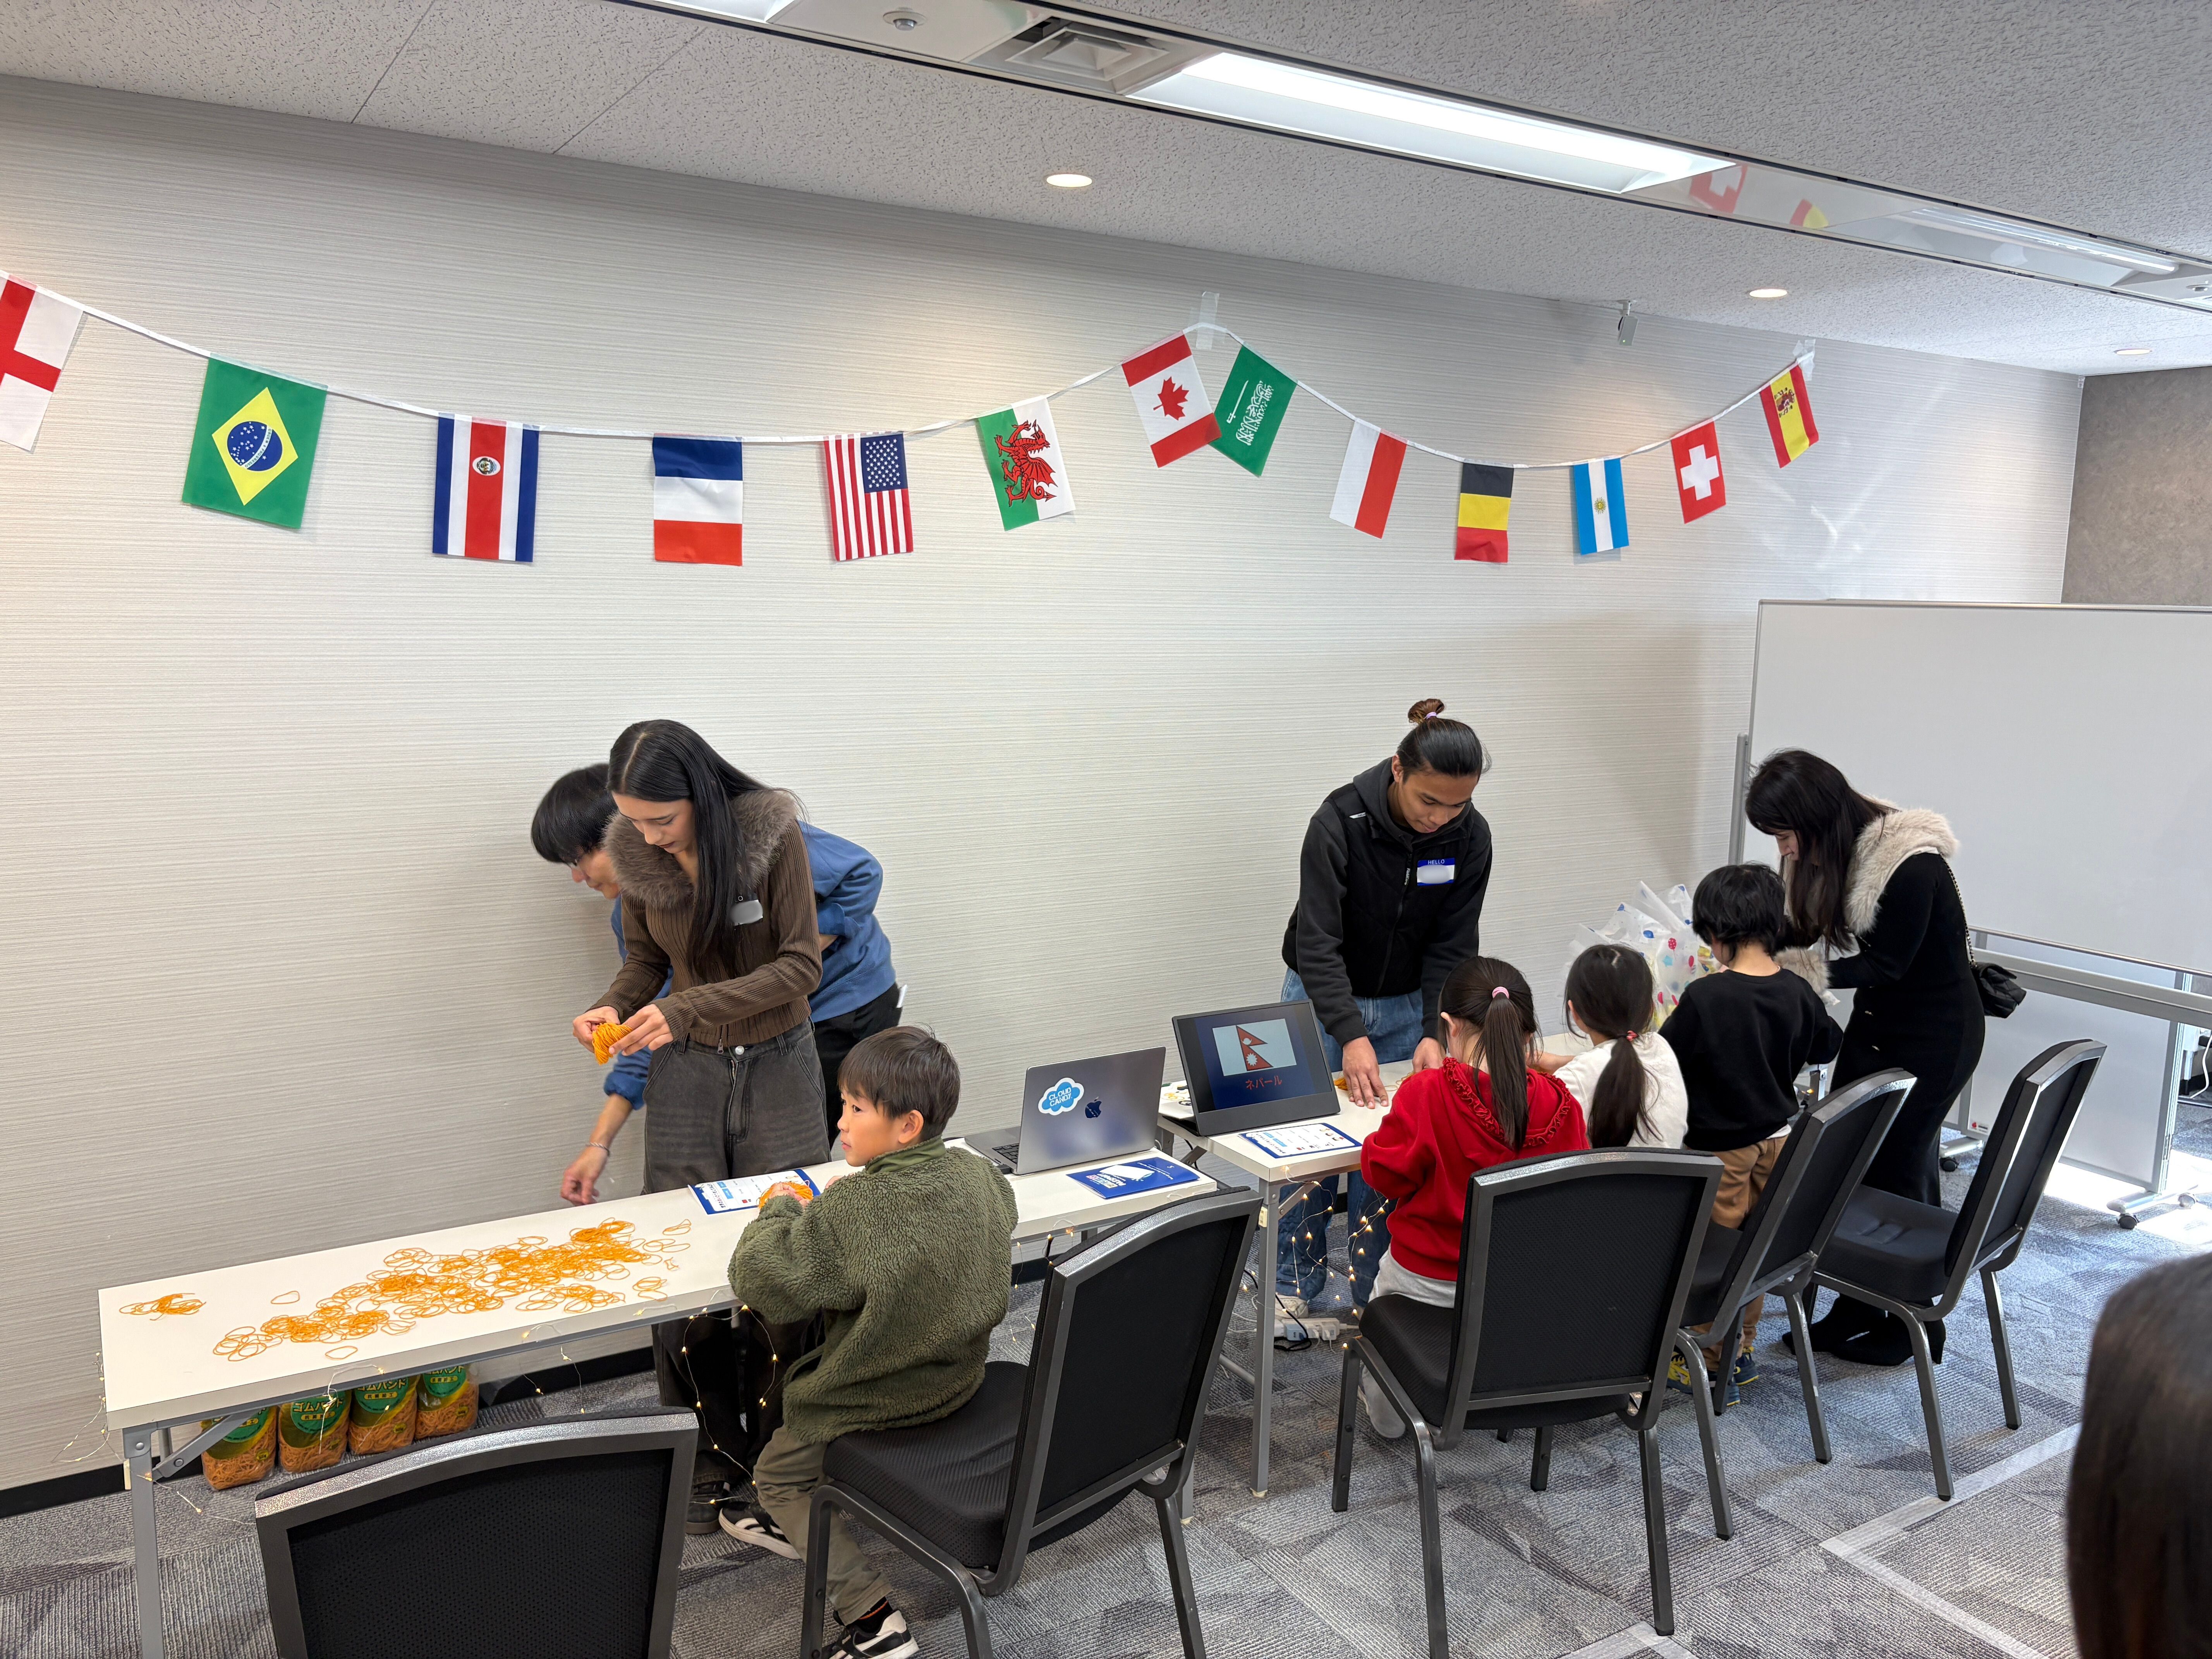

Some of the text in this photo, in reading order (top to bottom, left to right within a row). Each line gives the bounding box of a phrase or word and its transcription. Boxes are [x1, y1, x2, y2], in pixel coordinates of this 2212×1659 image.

[1245, 1075, 1282, 1090] ネパール
[1049, 1087, 1071, 1101] CLOUD
[1050, 1093, 1071, 1106] CANDY
